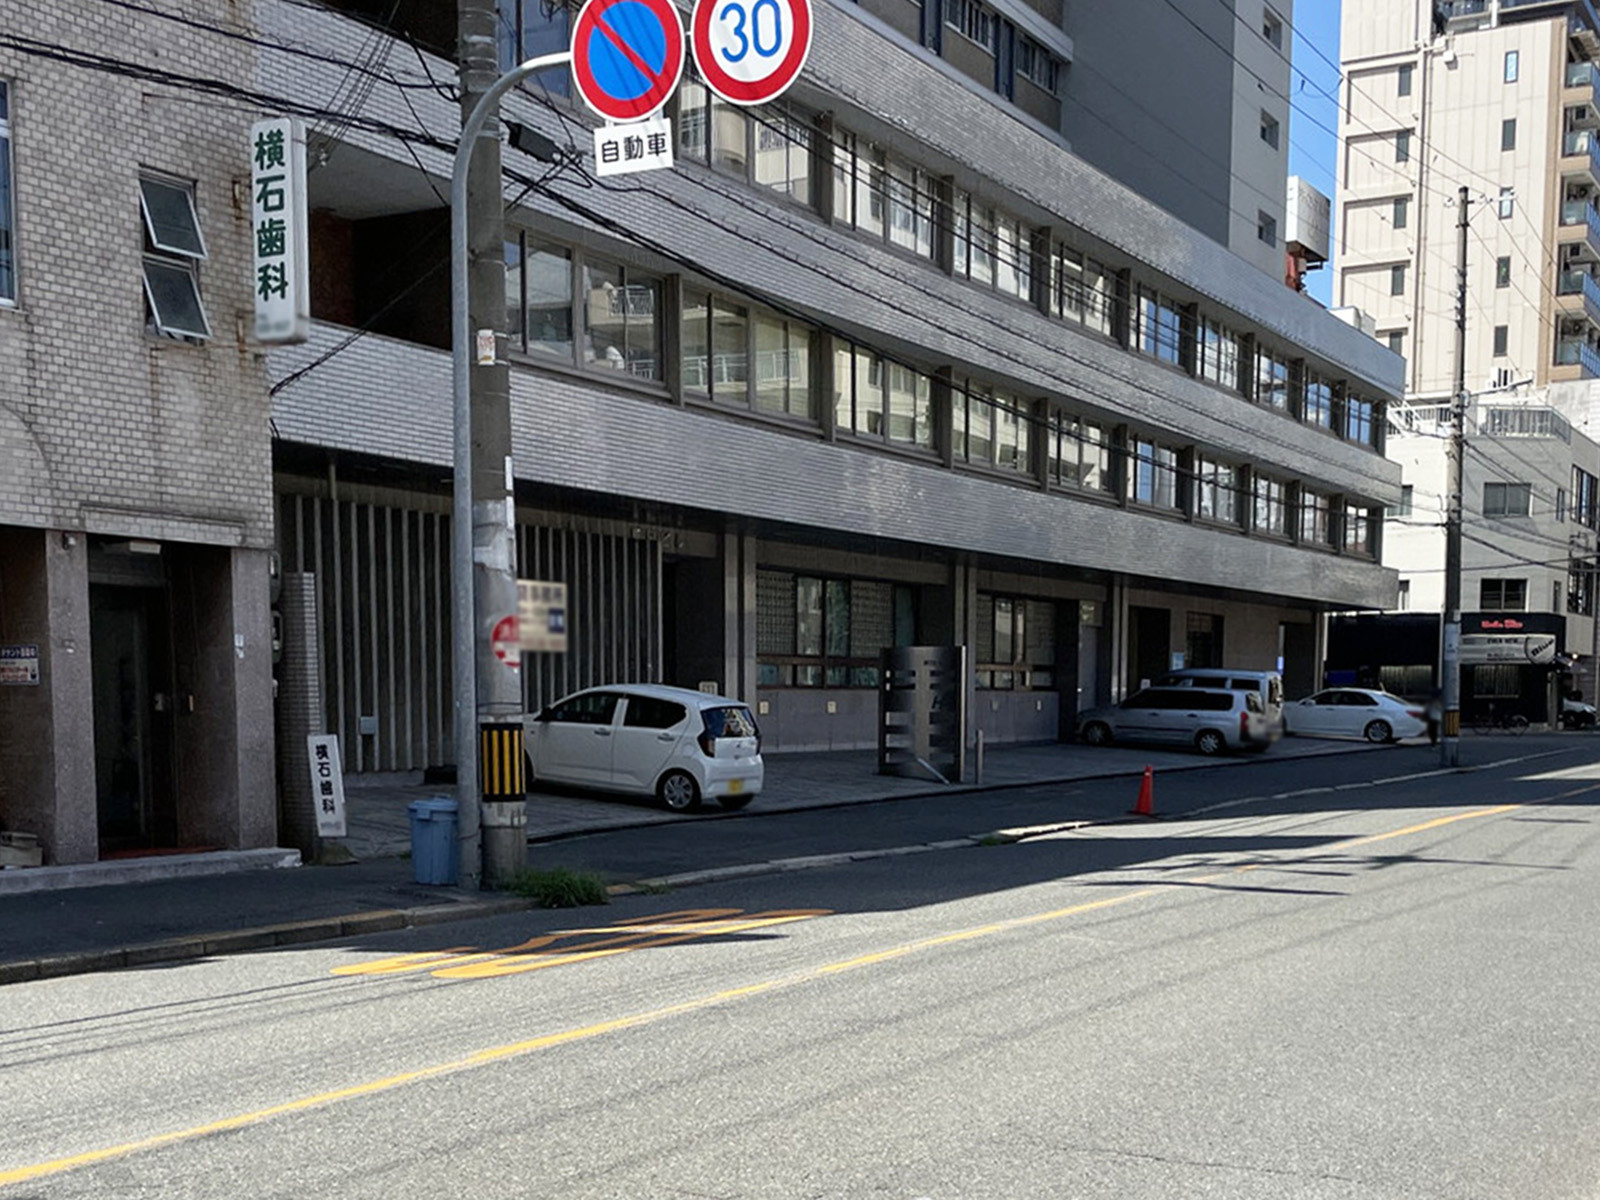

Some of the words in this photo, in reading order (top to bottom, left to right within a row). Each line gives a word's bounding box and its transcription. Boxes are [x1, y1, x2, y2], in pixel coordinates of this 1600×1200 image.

[720, 0, 782, 63] 30
[602, 132, 666, 163] 自動車
[254, 128, 288, 302] 横石歯科
[315, 744, 335, 814] 横石歯科
